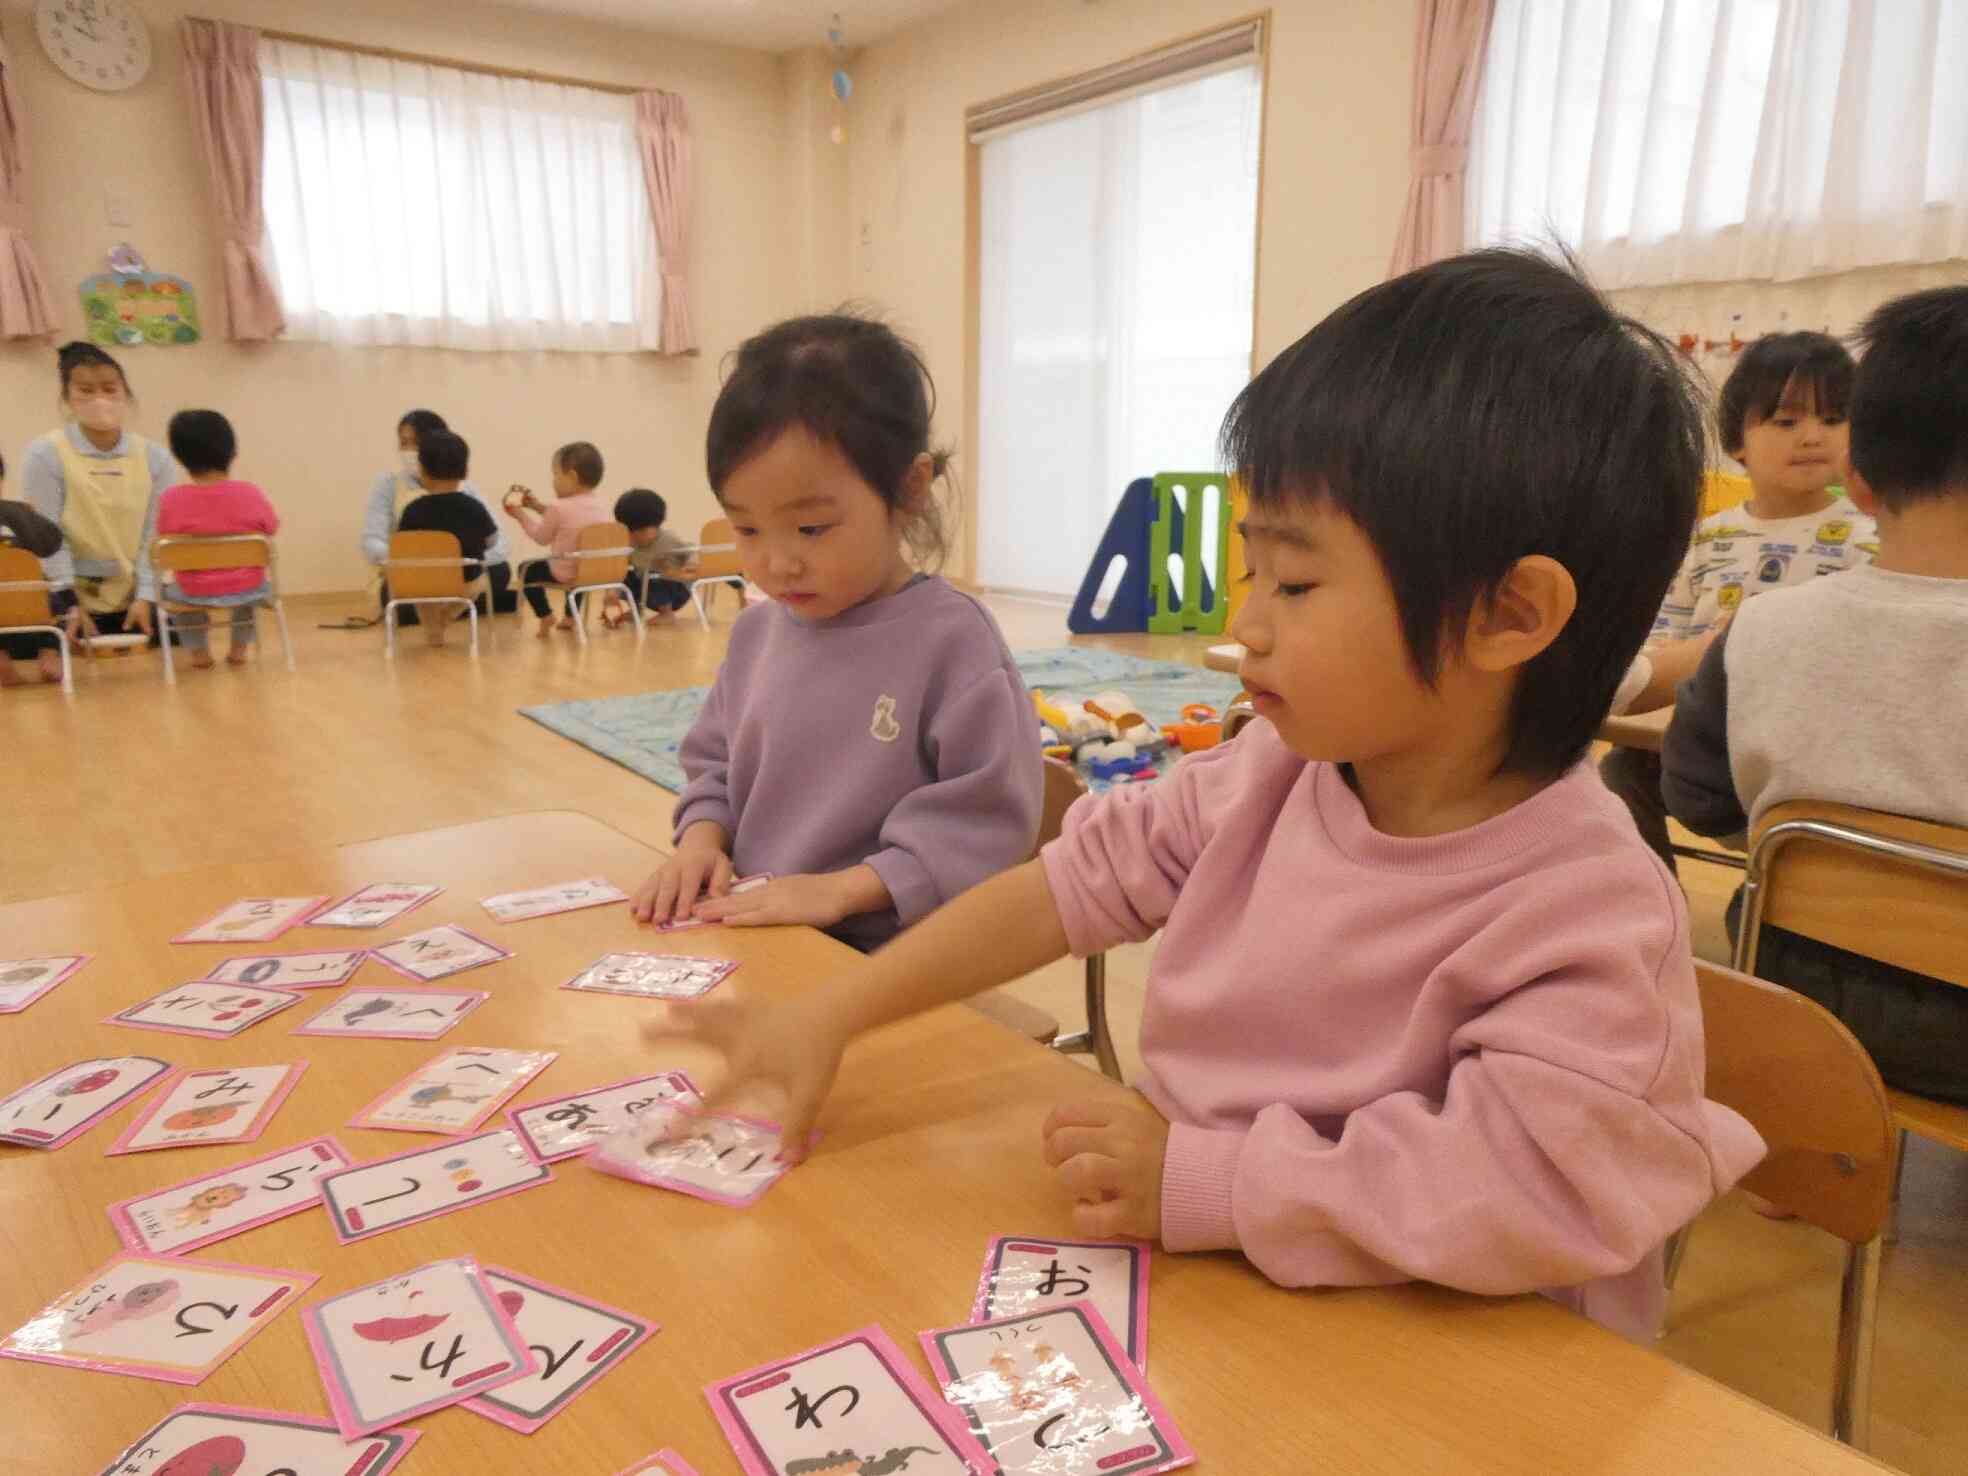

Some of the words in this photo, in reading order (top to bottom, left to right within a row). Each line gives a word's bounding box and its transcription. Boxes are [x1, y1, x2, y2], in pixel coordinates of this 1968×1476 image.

[455, 1062, 501, 1075] へ
[195, 1076, 255, 1099] み
[259, 1163, 319, 1192] ら
[362, 1176, 421, 1207] し
[1036, 1259, 1093, 1297] お
[175, 1301, 240, 1339] ひ
[390, 1333, 468, 1383] か
[785, 1384, 860, 1430] わ
